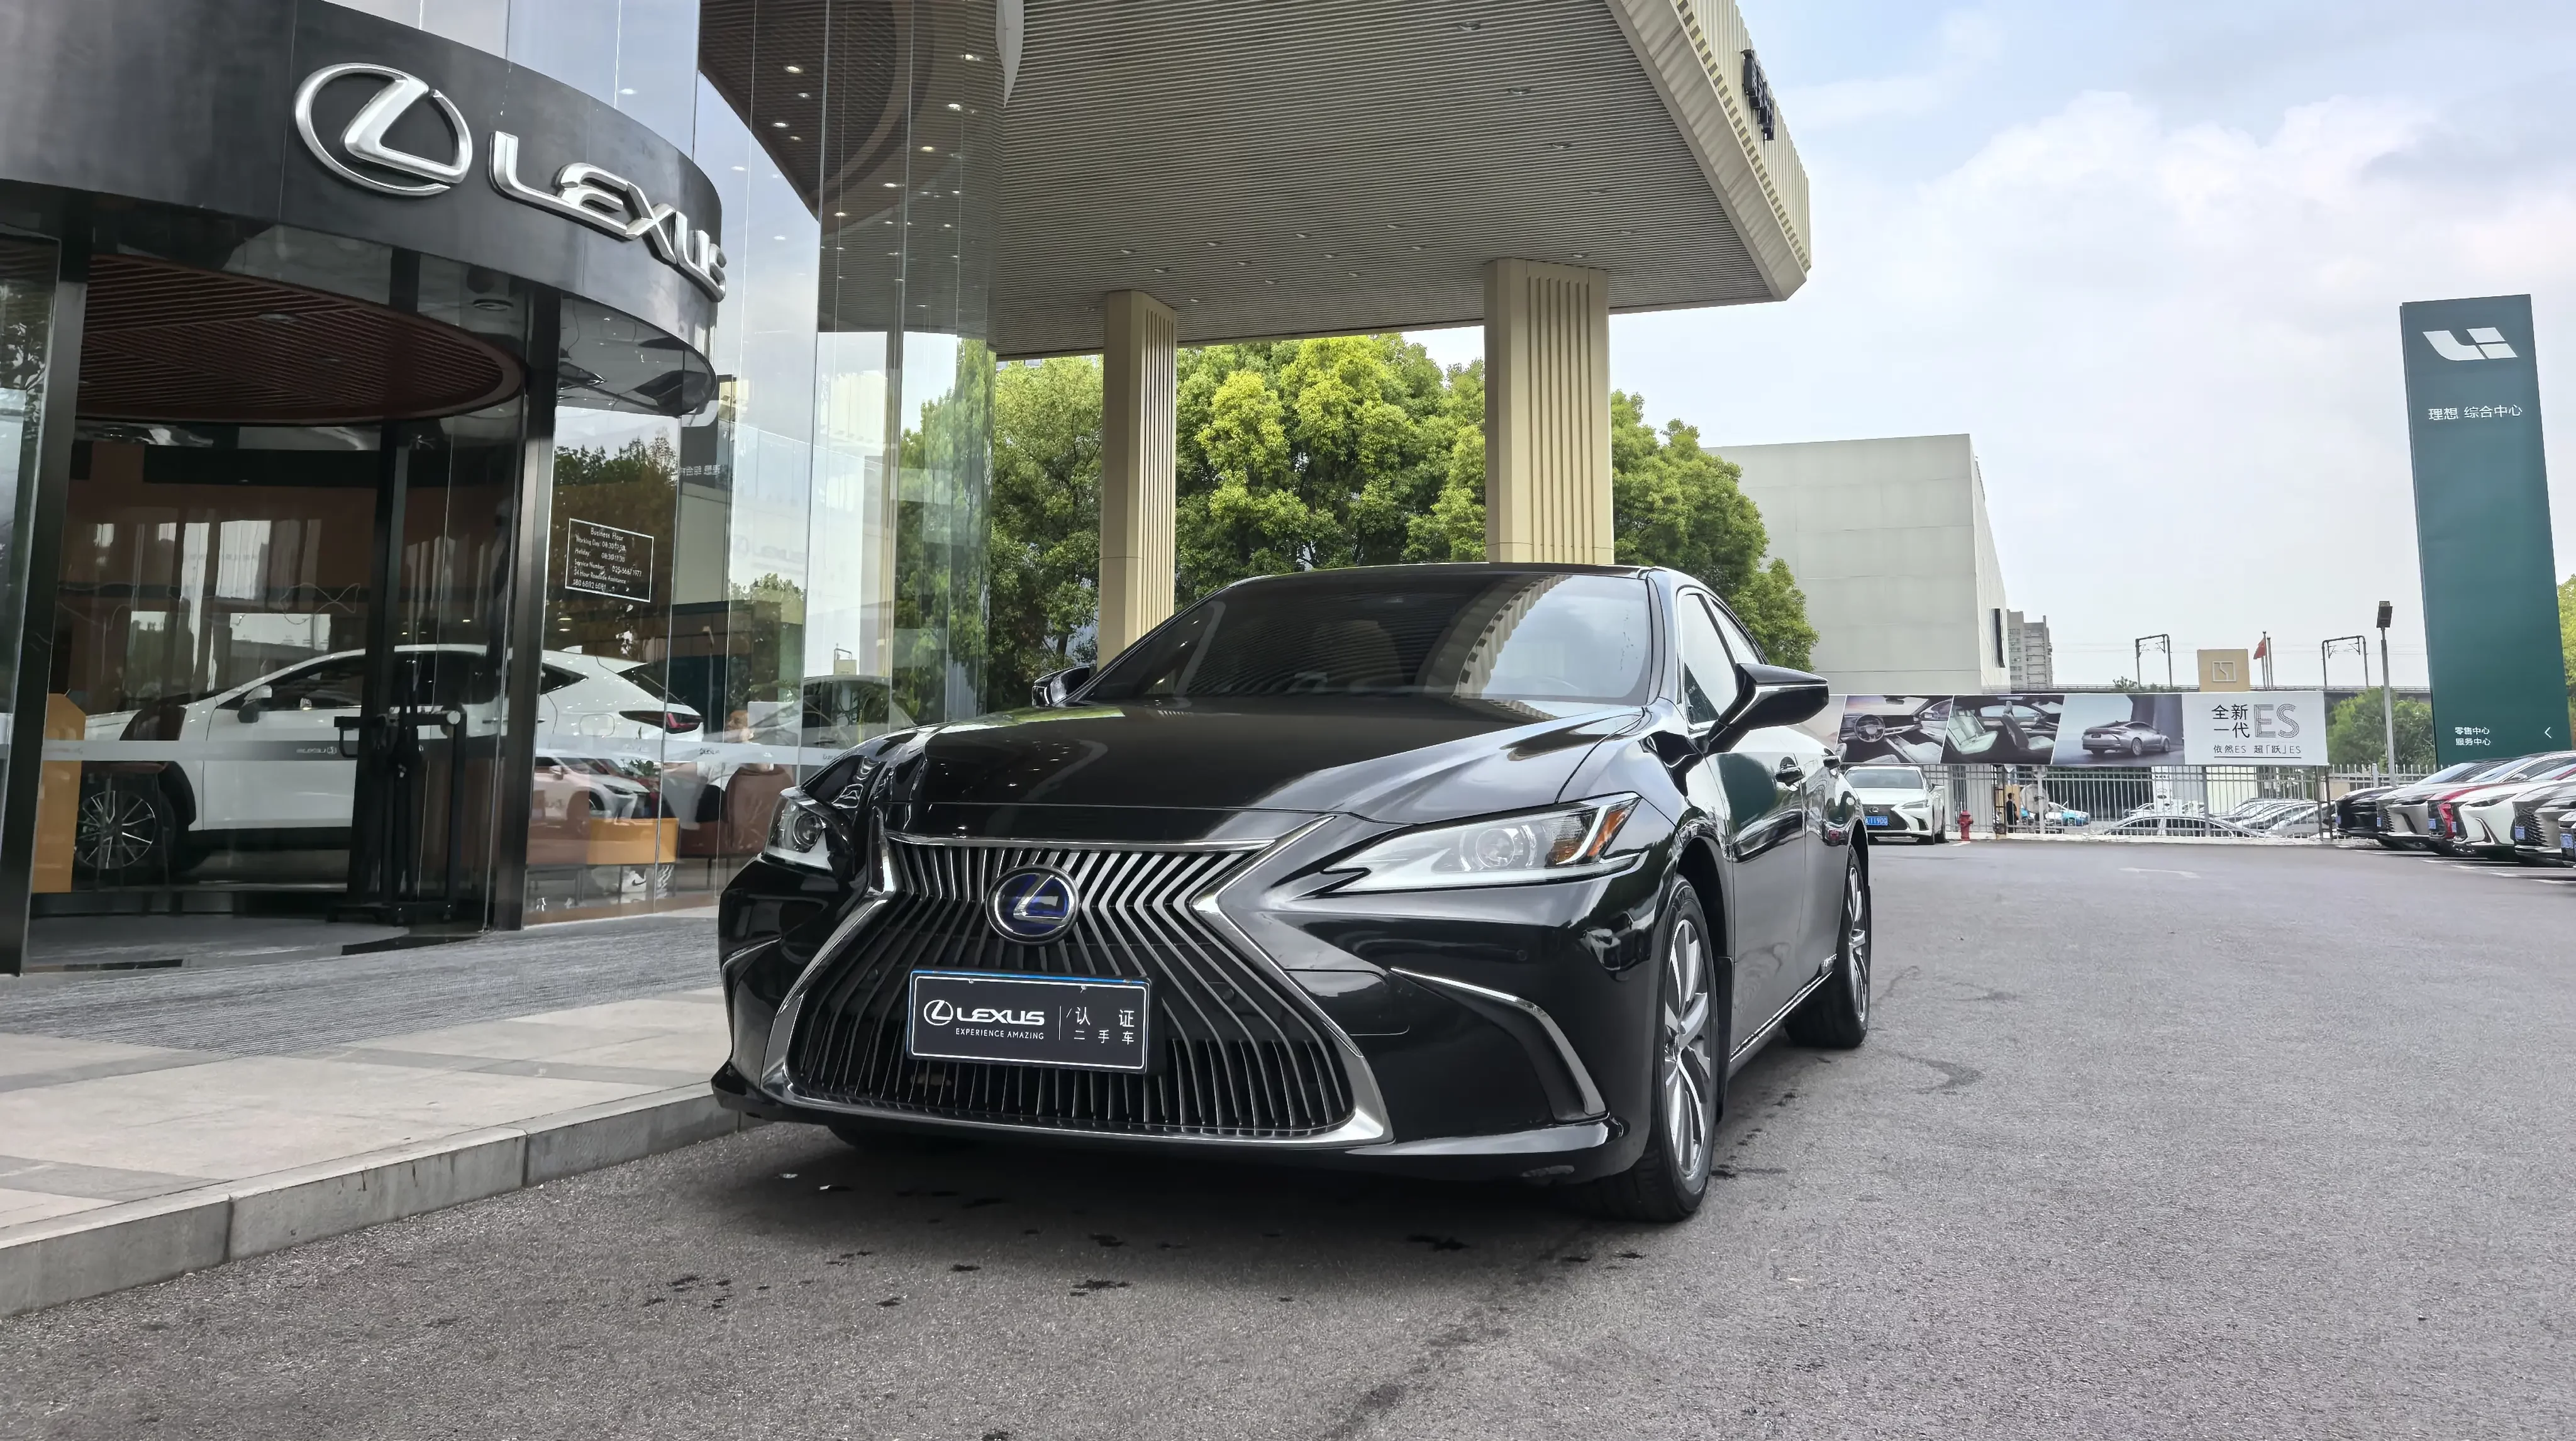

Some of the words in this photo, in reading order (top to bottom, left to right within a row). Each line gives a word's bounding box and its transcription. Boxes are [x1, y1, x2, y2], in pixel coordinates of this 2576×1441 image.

[489, 130, 727, 303] LEXUS
[2428, 408, 2458, 420] 理想
[2464, 404, 2523, 418] 综合中心
[591, 527, 610, 538] Business
[2211, 704, 2248, 720] 全新
[2254, 704, 2300, 738] ES
[2214, 722, 2250, 738] 一代
[2214, 745, 2246, 754] 依然ES
[957, 1007, 1045, 1026] LEXUS
[956, 1028, 1004, 1038] EXPERIENCE
[1008, 1031, 1044, 1040] AMAZING
